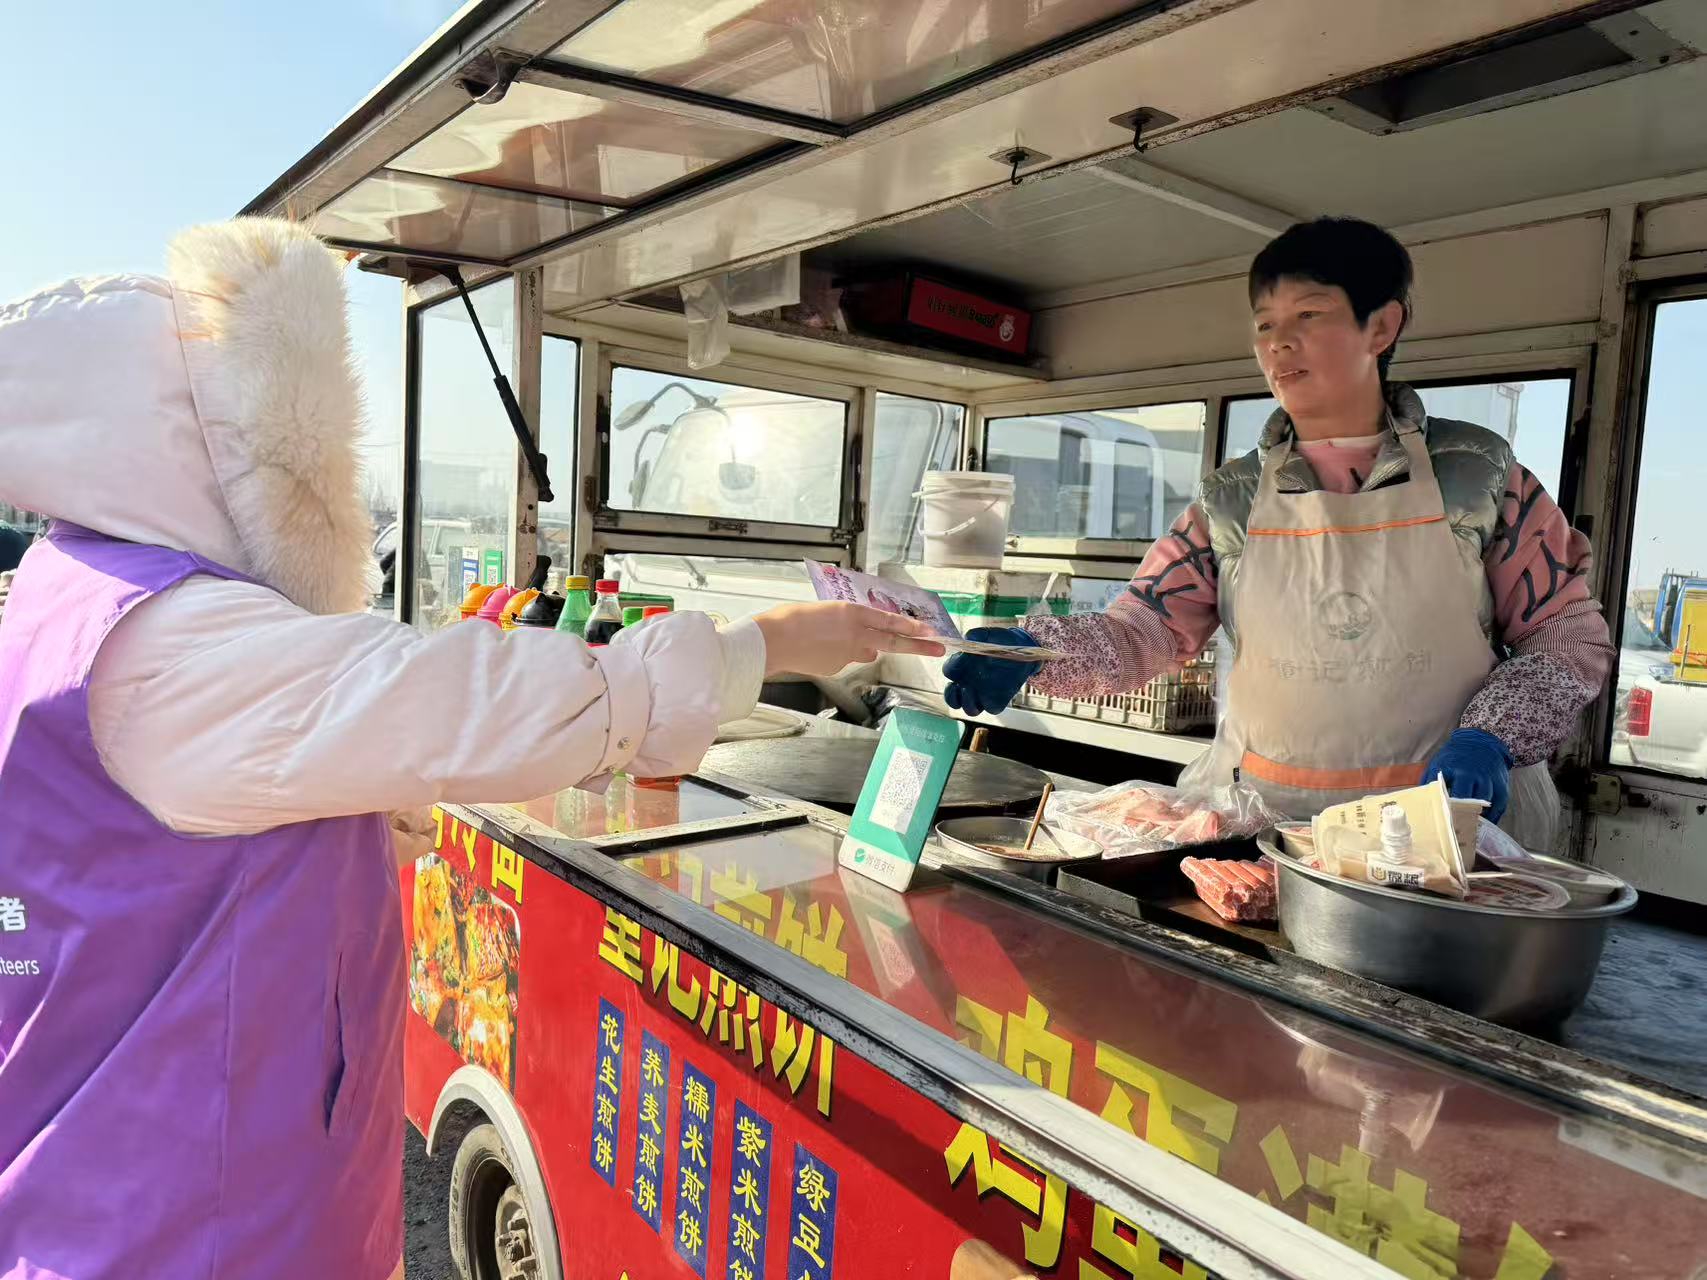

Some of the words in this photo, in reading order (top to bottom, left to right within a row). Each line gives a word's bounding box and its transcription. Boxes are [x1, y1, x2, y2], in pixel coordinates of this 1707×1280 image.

[0, 896, 26, 931] 者
[0, 956, 40, 975] teers
[592, 1013, 622, 1174] 花生煎饼
[636, 1047, 665, 1218] 荞麦煎饼
[677, 1075, 711, 1256] 糯米煎饼
[793, 1163, 831, 1280] 绿豆
